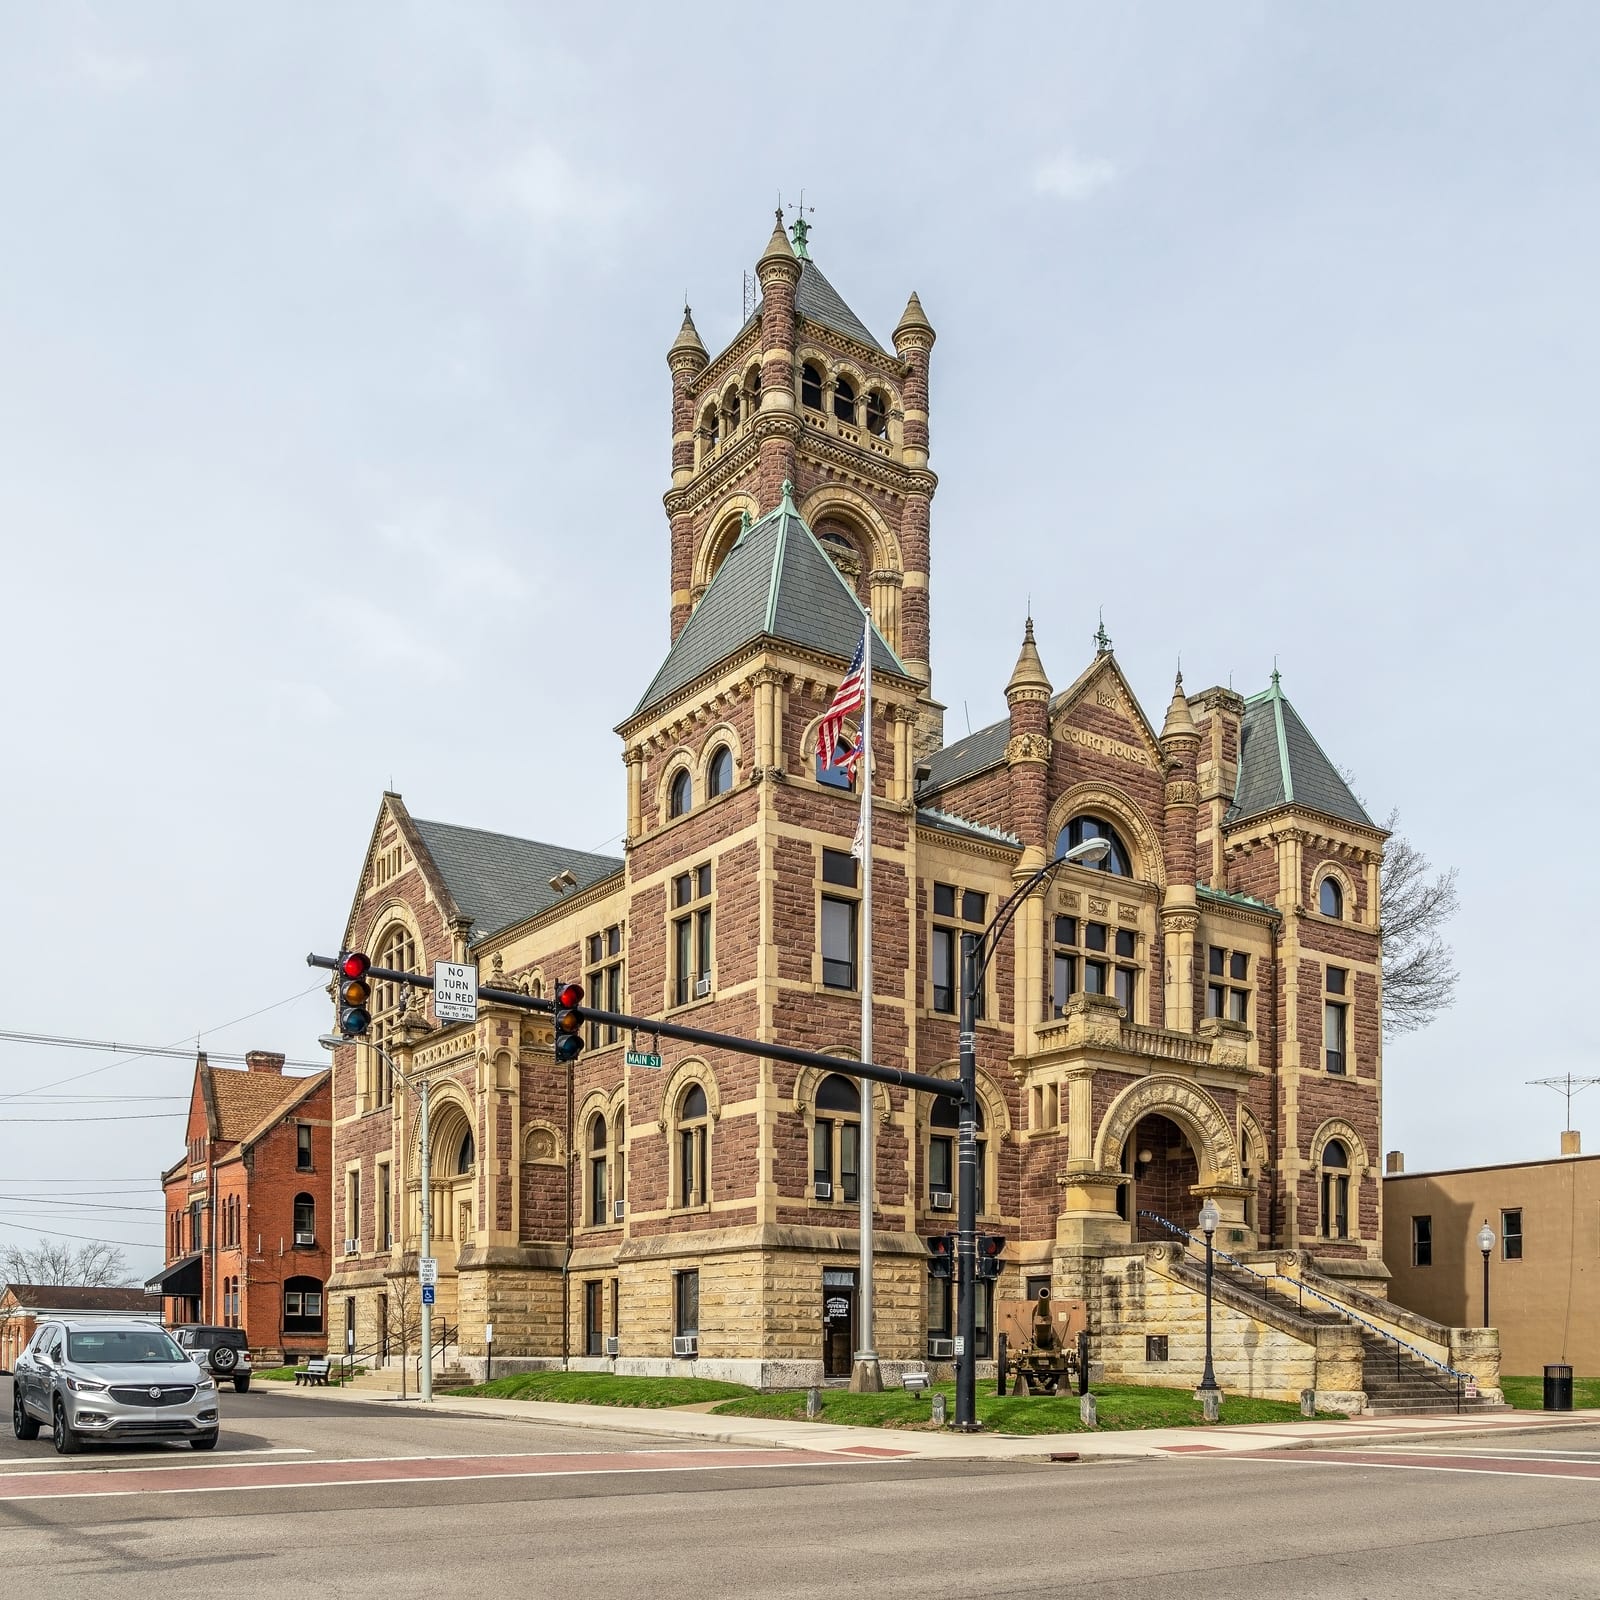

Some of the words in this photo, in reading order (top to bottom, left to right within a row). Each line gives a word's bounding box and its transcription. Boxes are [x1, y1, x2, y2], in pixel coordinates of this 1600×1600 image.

[1096, 690, 1116, 710] 1887
[1062, 728, 1103, 751] COURT
[1107, 741, 1148, 765] HOUSE
[448, 967, 464, 977] NO
[443, 979, 469, 990] TURN
[438, 990, 451, 1001] ON
[455, 992, 474, 1003] RED
[628, 1054, 647, 1064] MAIN
[650, 1057, 660, 1067] ST
